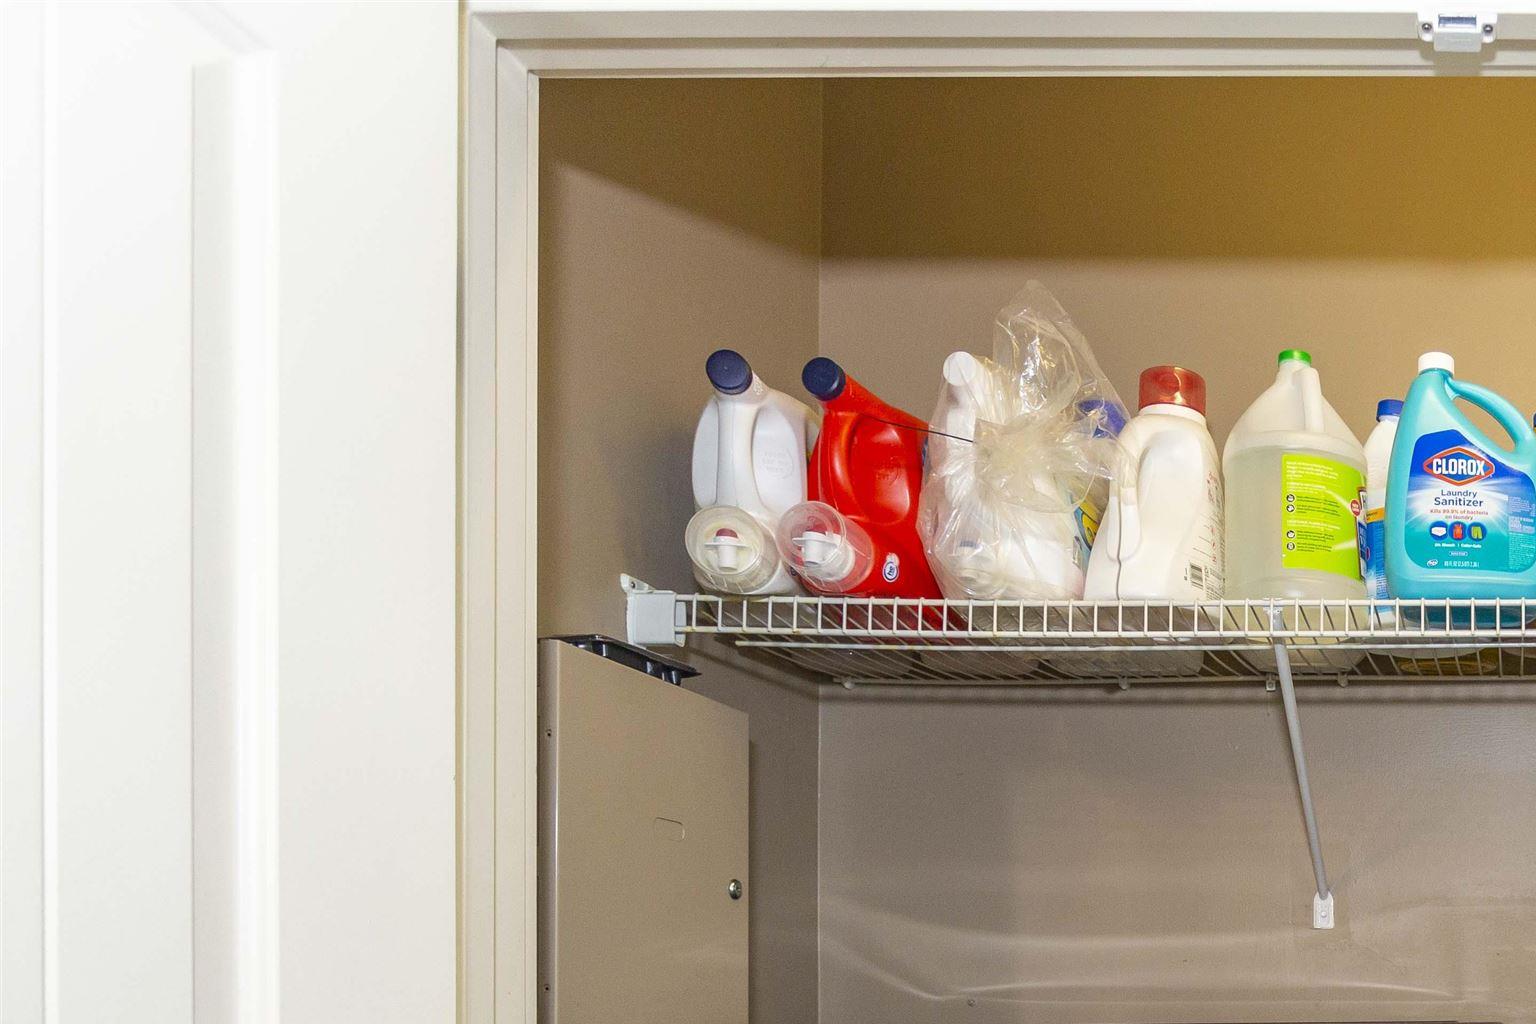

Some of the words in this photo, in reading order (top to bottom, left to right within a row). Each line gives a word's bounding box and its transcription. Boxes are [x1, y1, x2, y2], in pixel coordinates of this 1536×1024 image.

[1432, 458, 1485, 476] CLOROX
[1440, 489, 1477, 498] Laundry
[1434, 497, 1484, 507] Sanitizer
